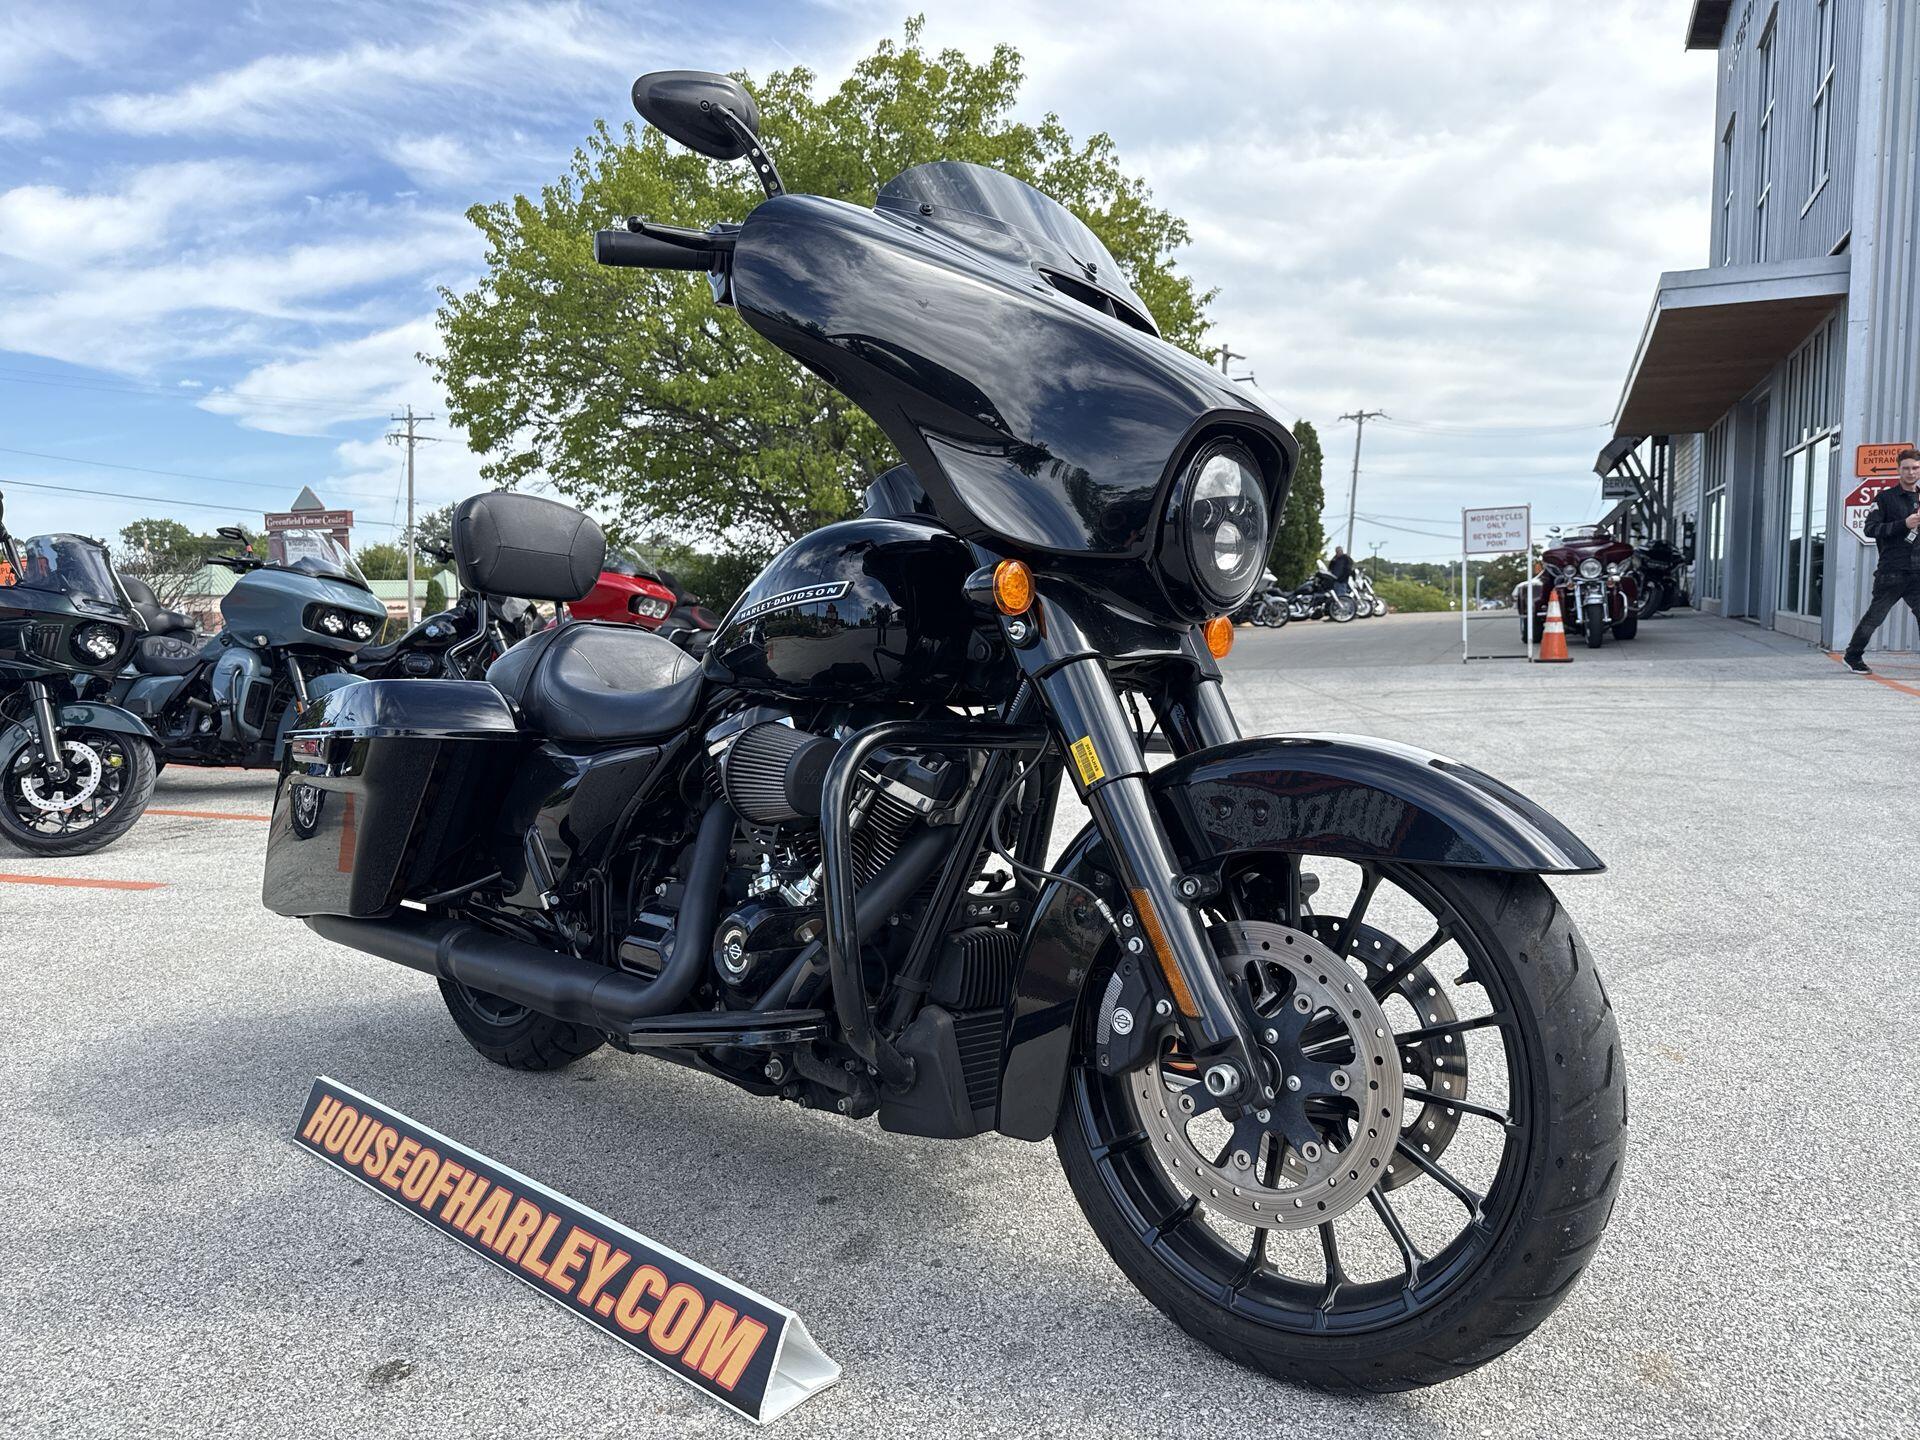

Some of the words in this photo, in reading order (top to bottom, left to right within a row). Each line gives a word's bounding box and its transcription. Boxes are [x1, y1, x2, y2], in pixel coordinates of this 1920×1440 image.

[1604, 477, 1633, 488] SERVIC
[1860, 487, 1891, 503] ST
[266, 516, 301, 527] Greenfield
[301, 516, 321, 525] Towne
[322, 515, 346, 525] Center
[1471, 513, 1523, 522] MOTORCYCLES
[1473, 532, 1502, 540] BEYOND
[740, 587, 838, 619] HARLEY-DAVIDSON
[302, 1094, 769, 1392] HOUSEOFHARLEY.COM
